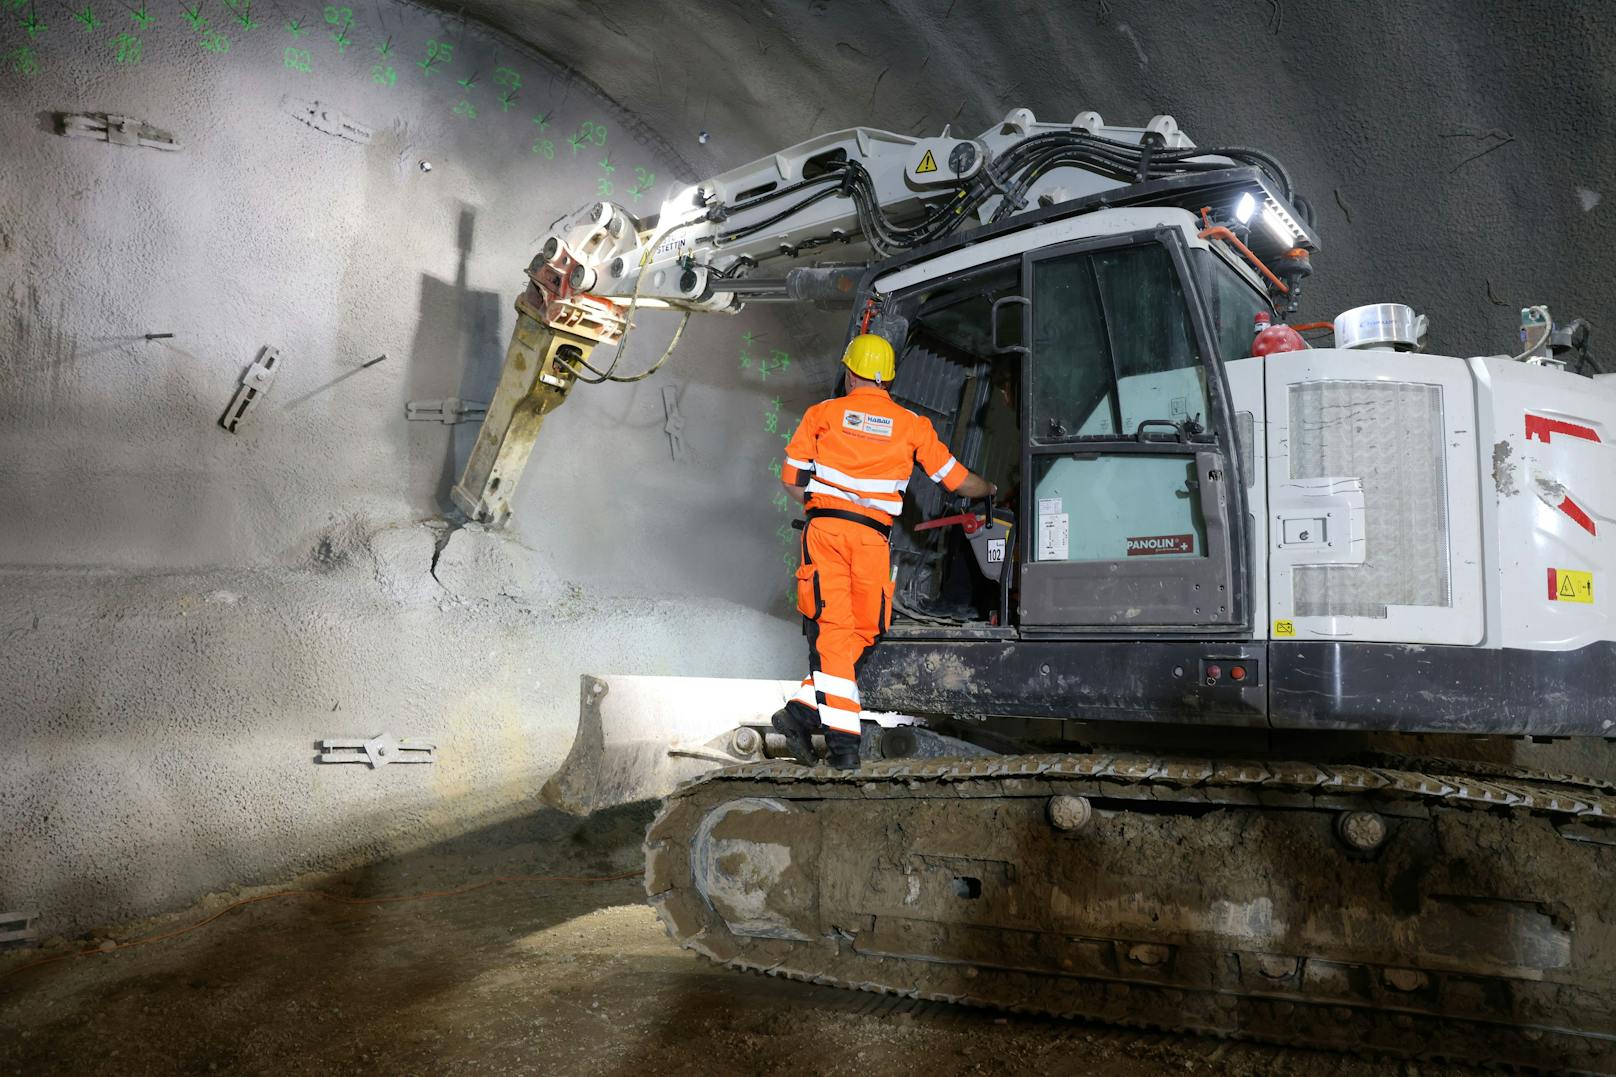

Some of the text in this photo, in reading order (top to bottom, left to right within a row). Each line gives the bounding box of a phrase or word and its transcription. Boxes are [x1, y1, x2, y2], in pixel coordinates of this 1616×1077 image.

[582, 121, 607, 146] 29
[656, 239, 686, 254] STETTIN
[763, 411, 777, 433] 38
[989, 549, 1001, 561] 102
